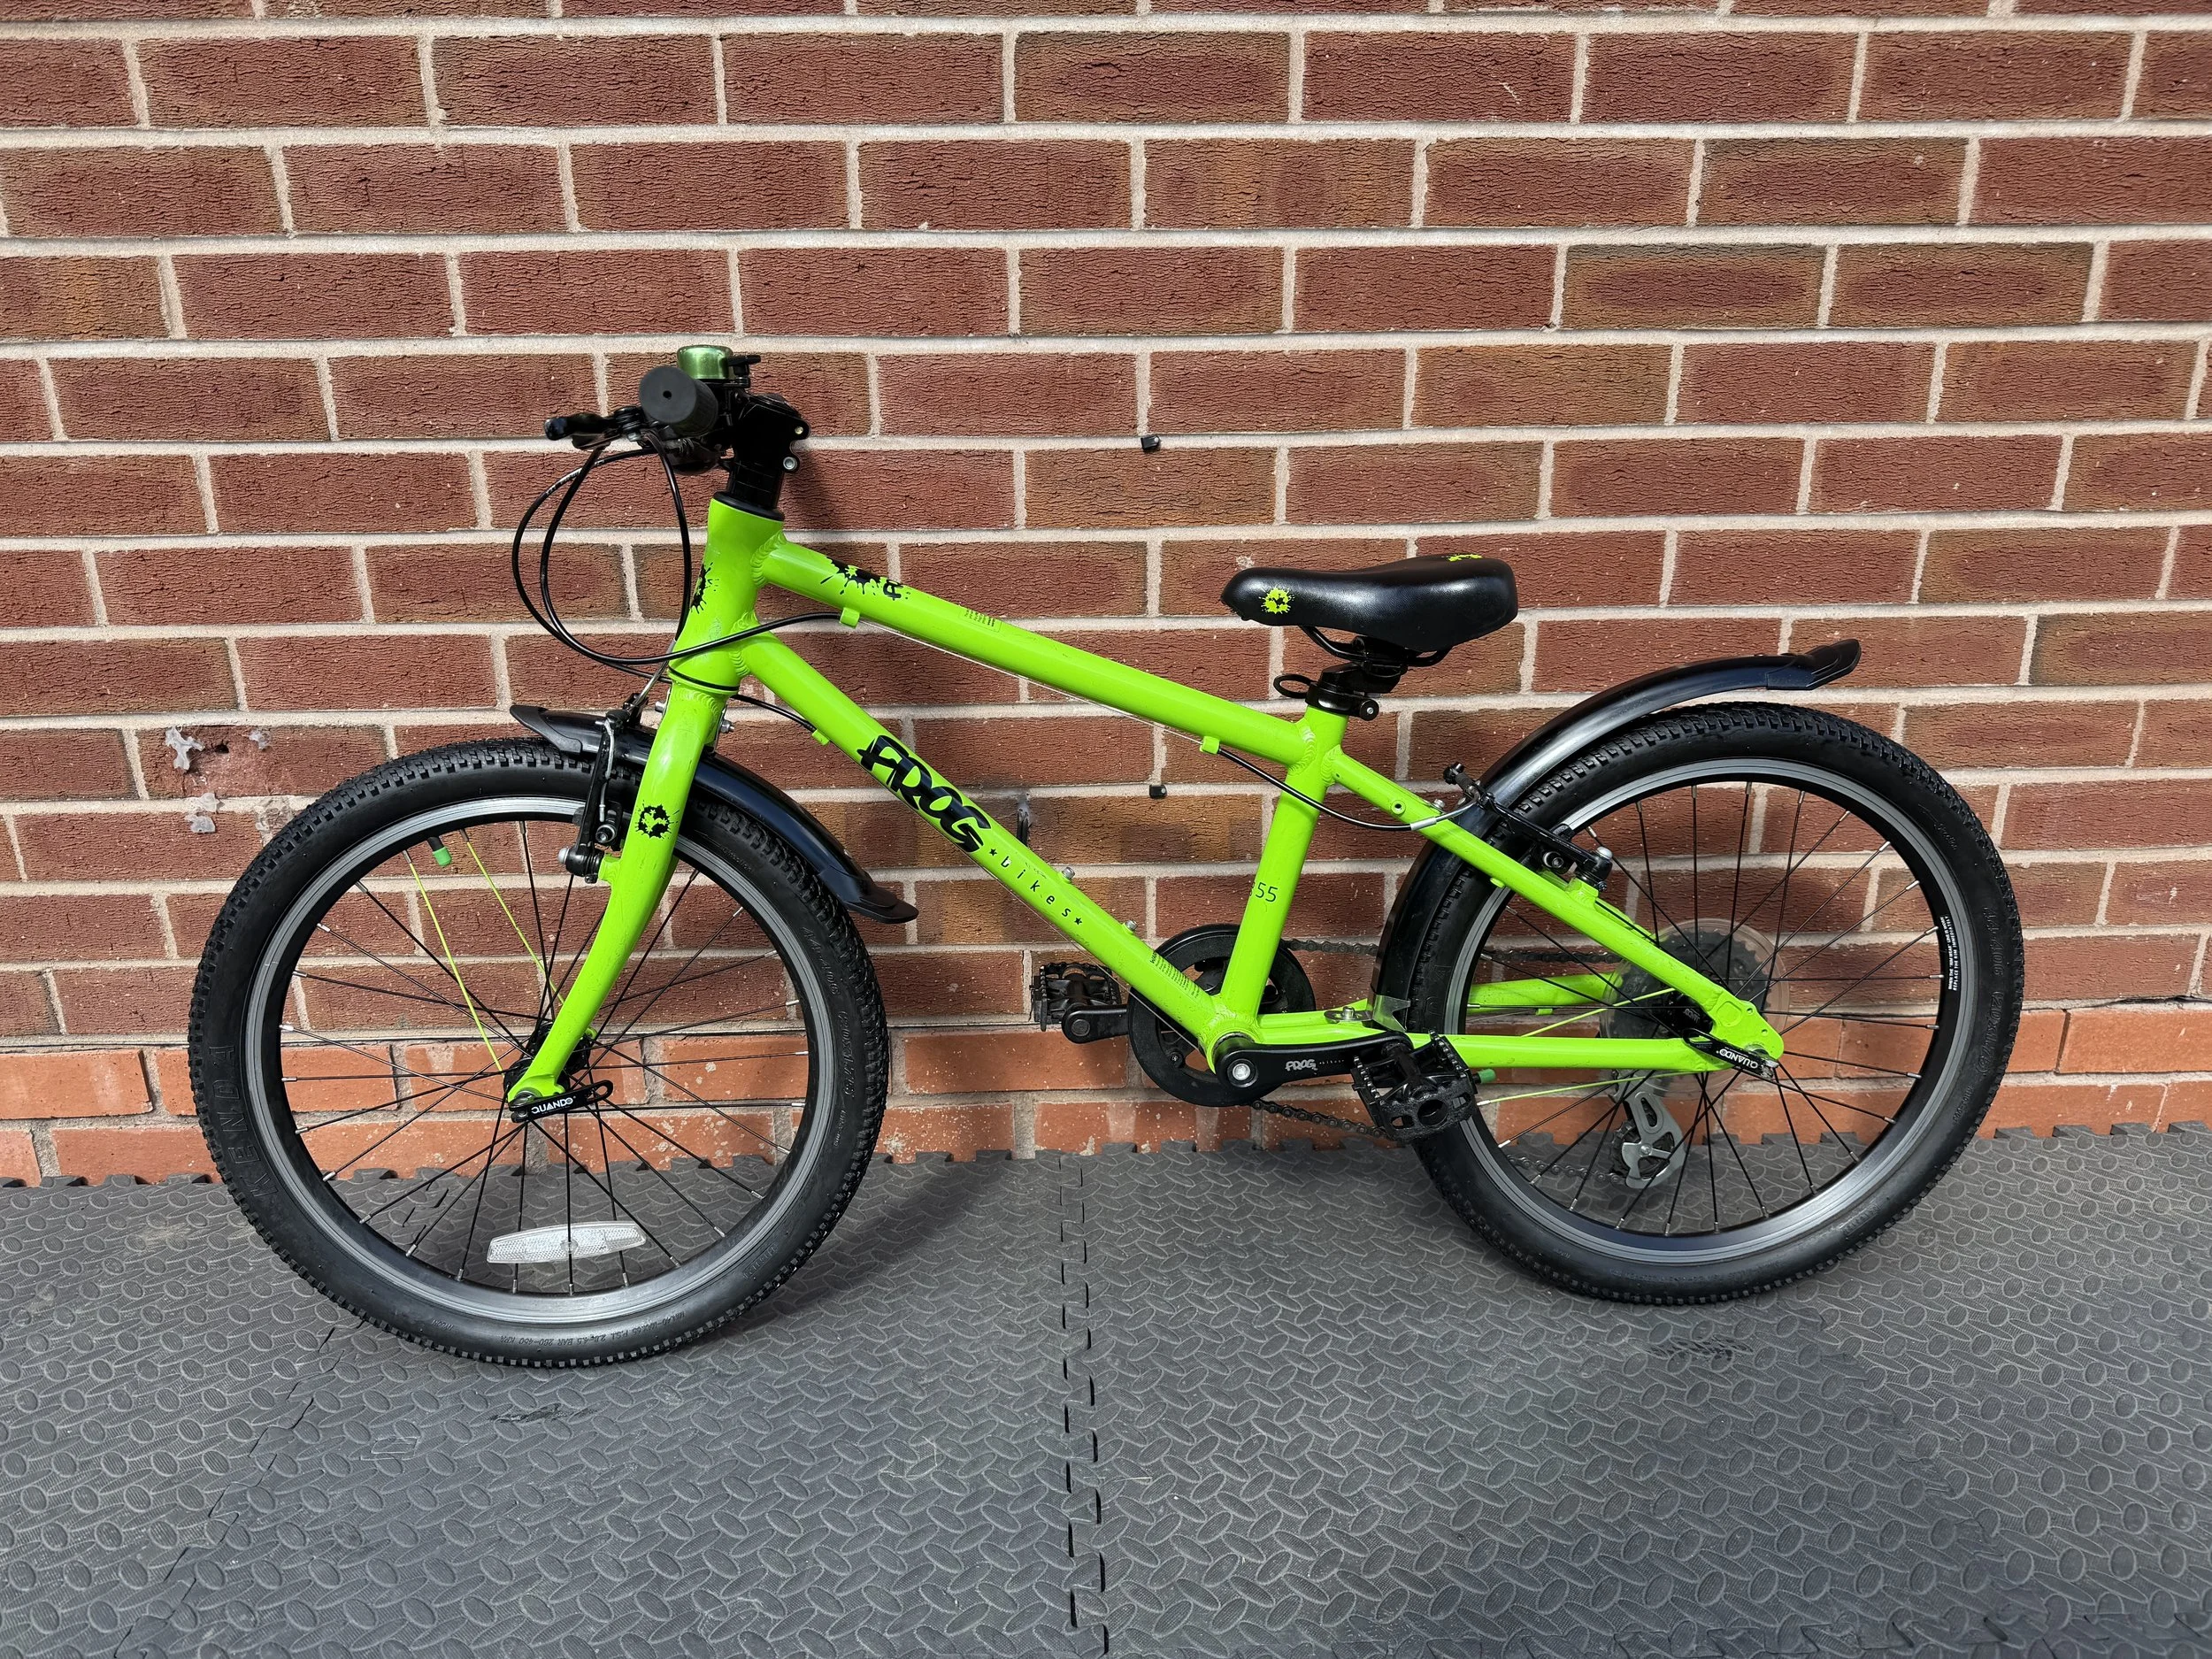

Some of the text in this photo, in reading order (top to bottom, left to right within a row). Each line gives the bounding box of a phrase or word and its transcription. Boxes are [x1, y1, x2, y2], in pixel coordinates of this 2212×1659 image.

[856, 734, 992, 854] FROG
[1001, 856, 1071, 918] bikes
[1255, 881, 1279, 902] 55
[1719, 1048, 1759, 1069] QUANDO
[531, 1097, 574, 1115] QUANDO
[209, 1045, 280, 1199] KENDA
[557, 1337, 573, 1347] BAR
